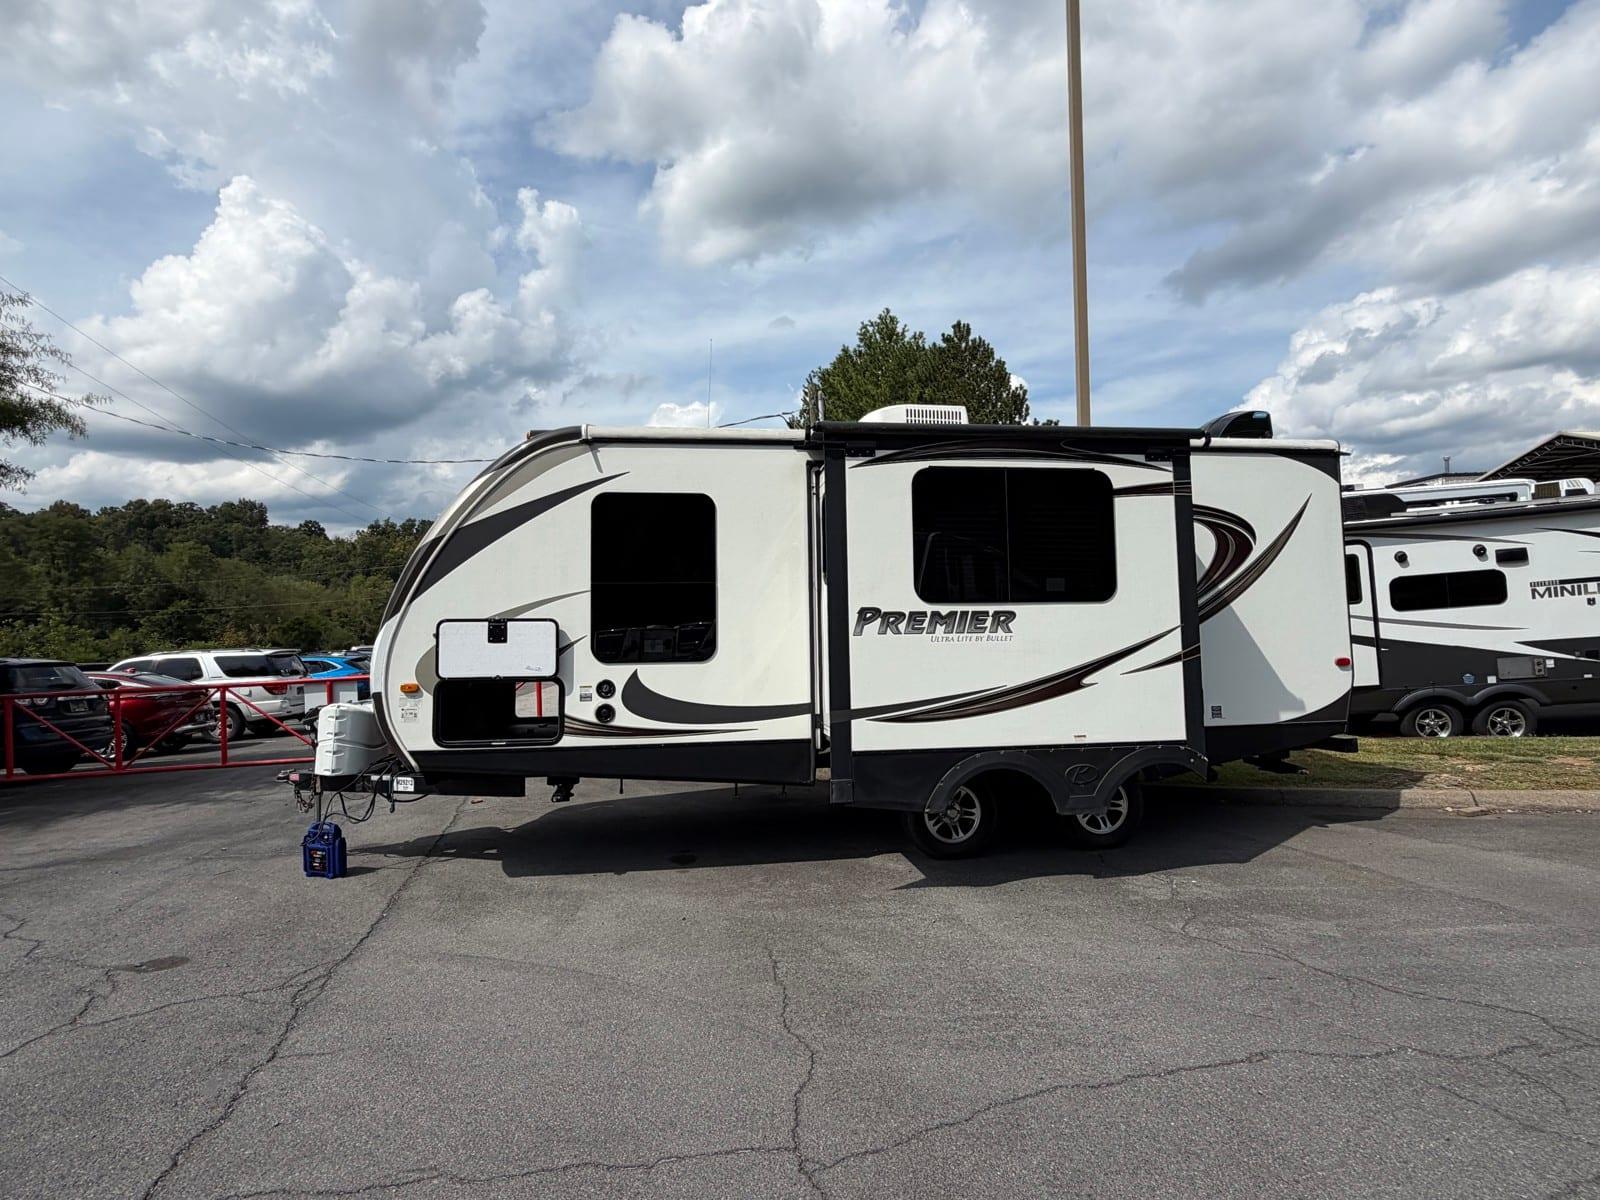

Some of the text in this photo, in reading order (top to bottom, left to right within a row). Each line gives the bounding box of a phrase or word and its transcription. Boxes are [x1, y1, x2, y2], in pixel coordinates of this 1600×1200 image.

[853, 606, 1017, 636] PREMIER
[930, 634, 1014, 643] ULTRA LITE BY BULLET
